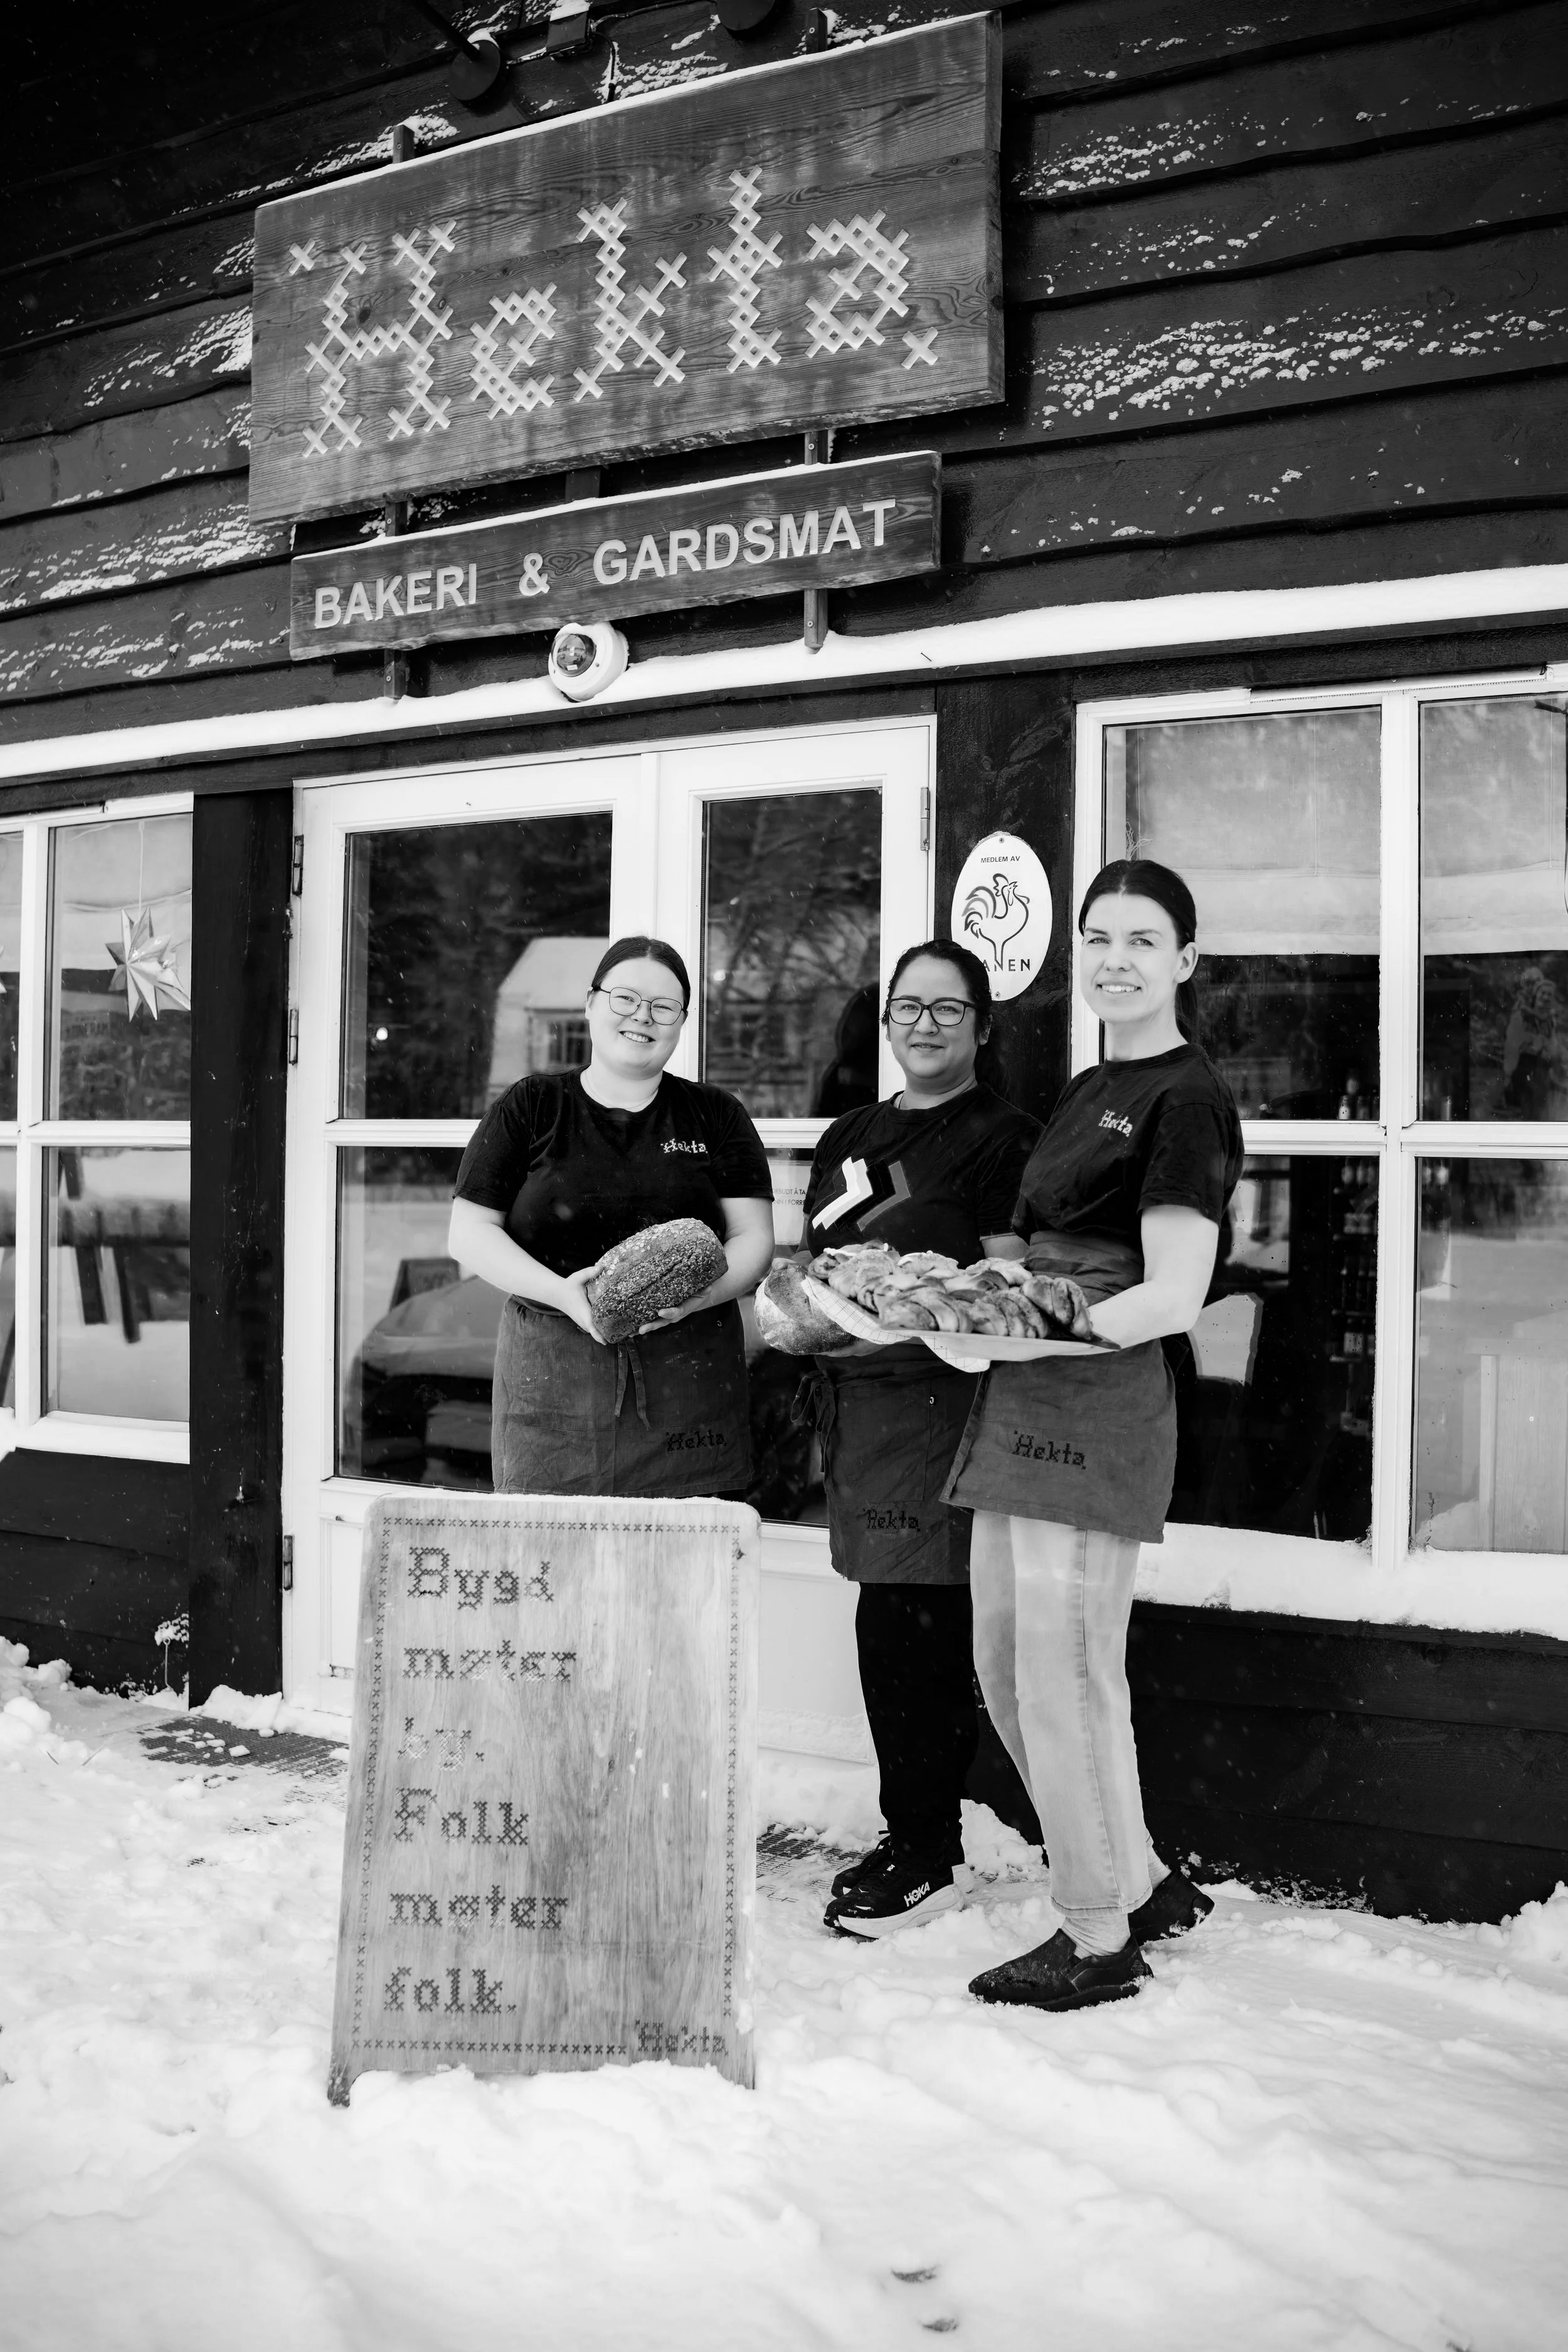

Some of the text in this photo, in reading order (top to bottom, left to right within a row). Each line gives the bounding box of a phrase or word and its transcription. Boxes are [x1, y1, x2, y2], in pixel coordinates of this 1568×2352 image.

[314, 499, 897, 628] BAKERI & GARDSMAT
[982, 959, 1030, 972] ANEN
[793, 1187, 798, 1195] Å
[406, 1546, 555, 1611] Bygd
[402, 1639, 577, 1683] møter
[393, 1785, 529, 1845] Folk
[389, 1884, 569, 1930] møter
[903, 1881, 930, 1907] HOKA
[384, 1966, 517, 2015] folk.
